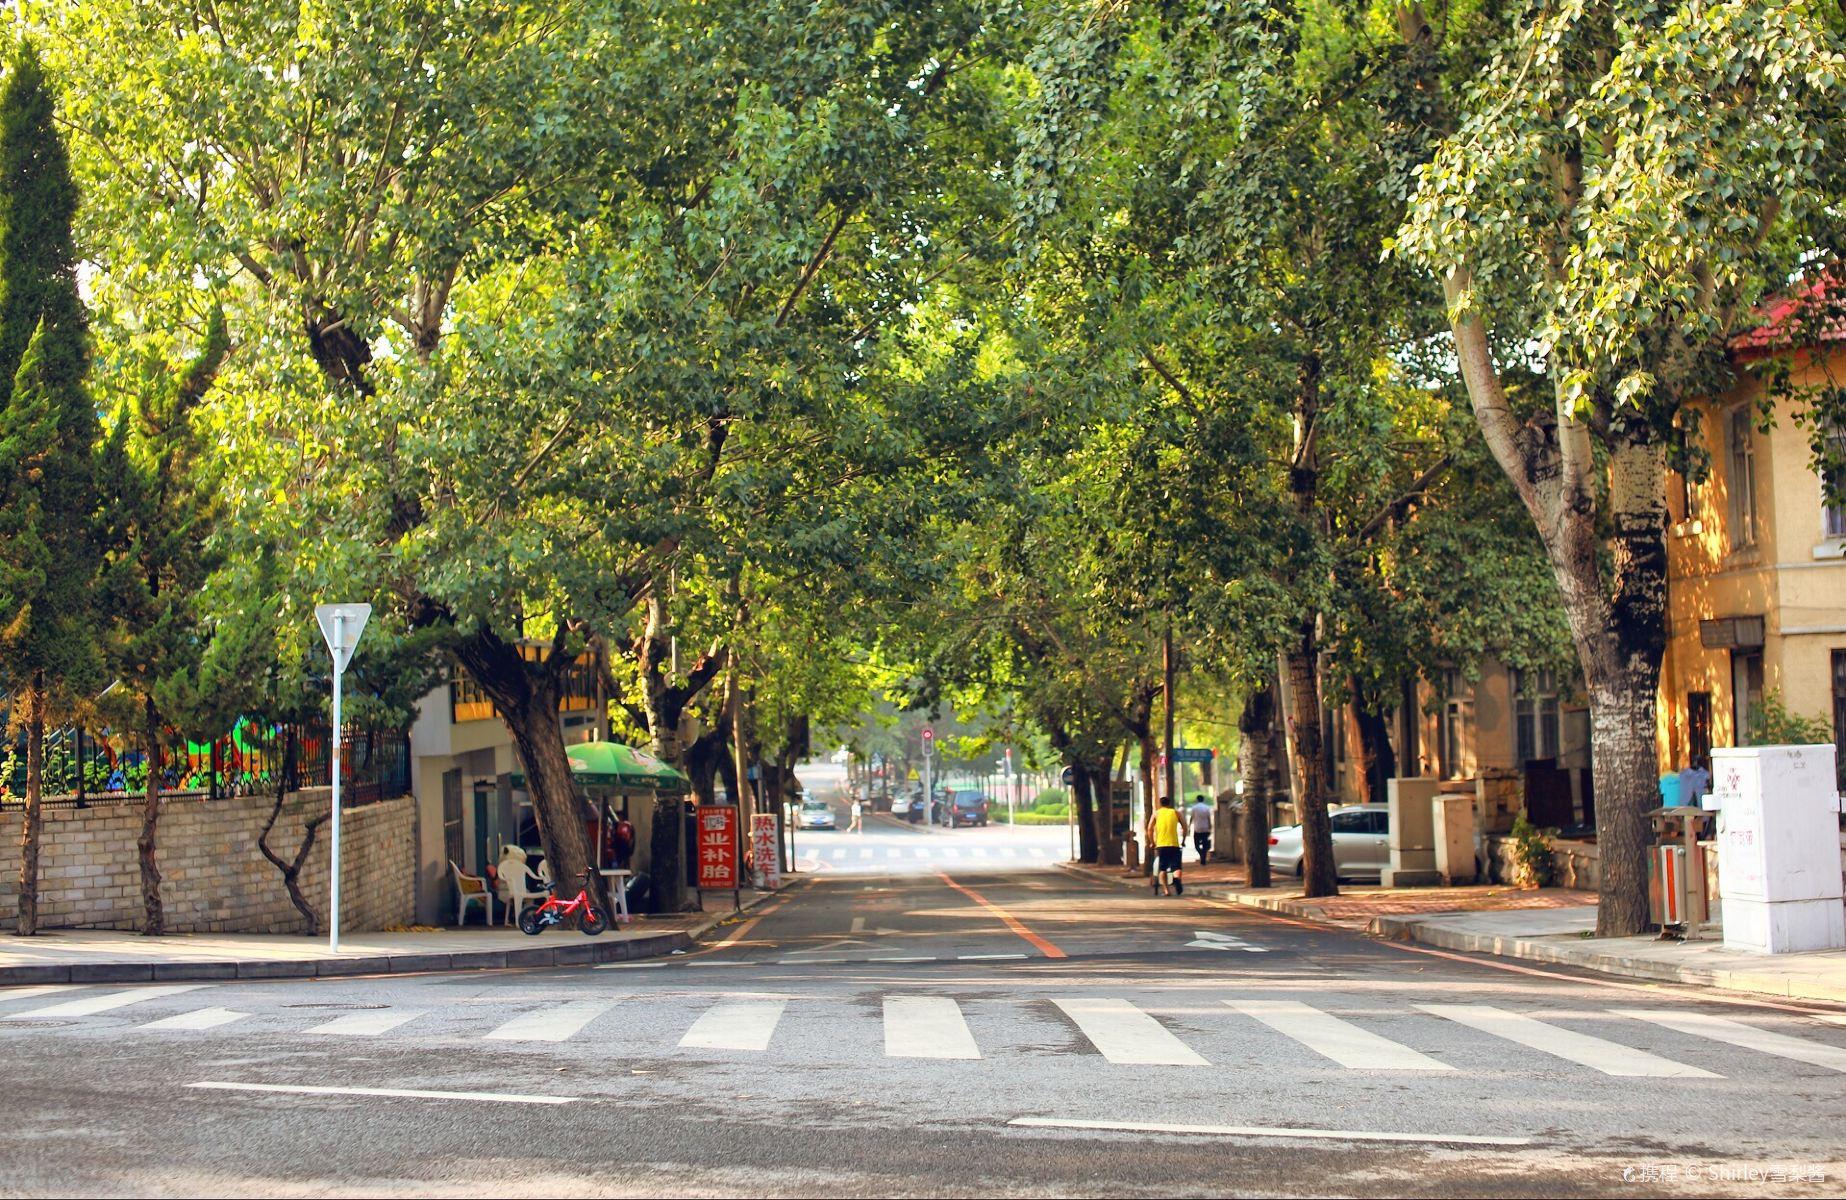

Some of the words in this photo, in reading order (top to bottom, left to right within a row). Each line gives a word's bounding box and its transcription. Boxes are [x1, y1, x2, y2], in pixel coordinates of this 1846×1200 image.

[701, 815, 731, 879] 业补胎
[754, 816, 776, 880] 热水洗车
